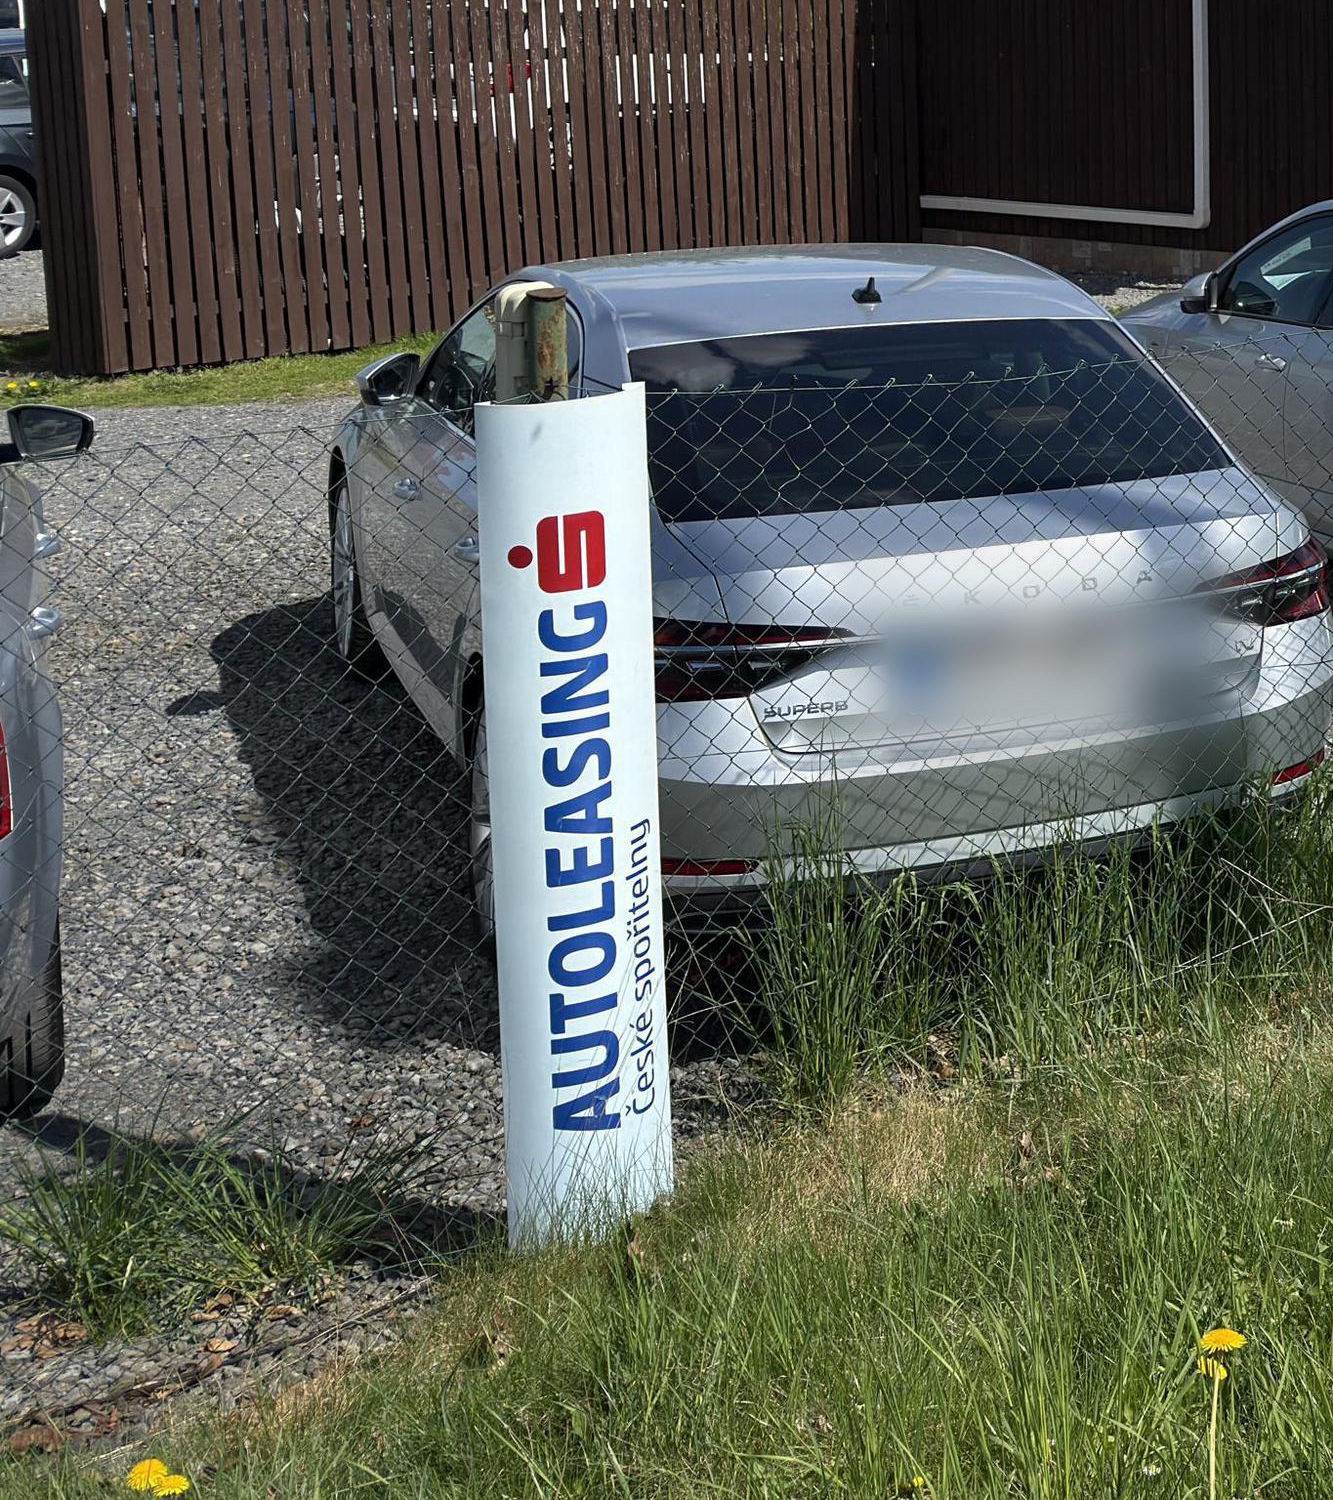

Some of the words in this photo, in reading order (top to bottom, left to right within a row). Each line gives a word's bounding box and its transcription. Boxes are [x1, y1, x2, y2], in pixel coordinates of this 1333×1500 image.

[763, 700, 849, 718] SUPERB
[538, 600, 622, 1134] AUTOLEASING
[625, 819, 653, 1002] spořitelny
[625, 1005, 656, 1116] České
